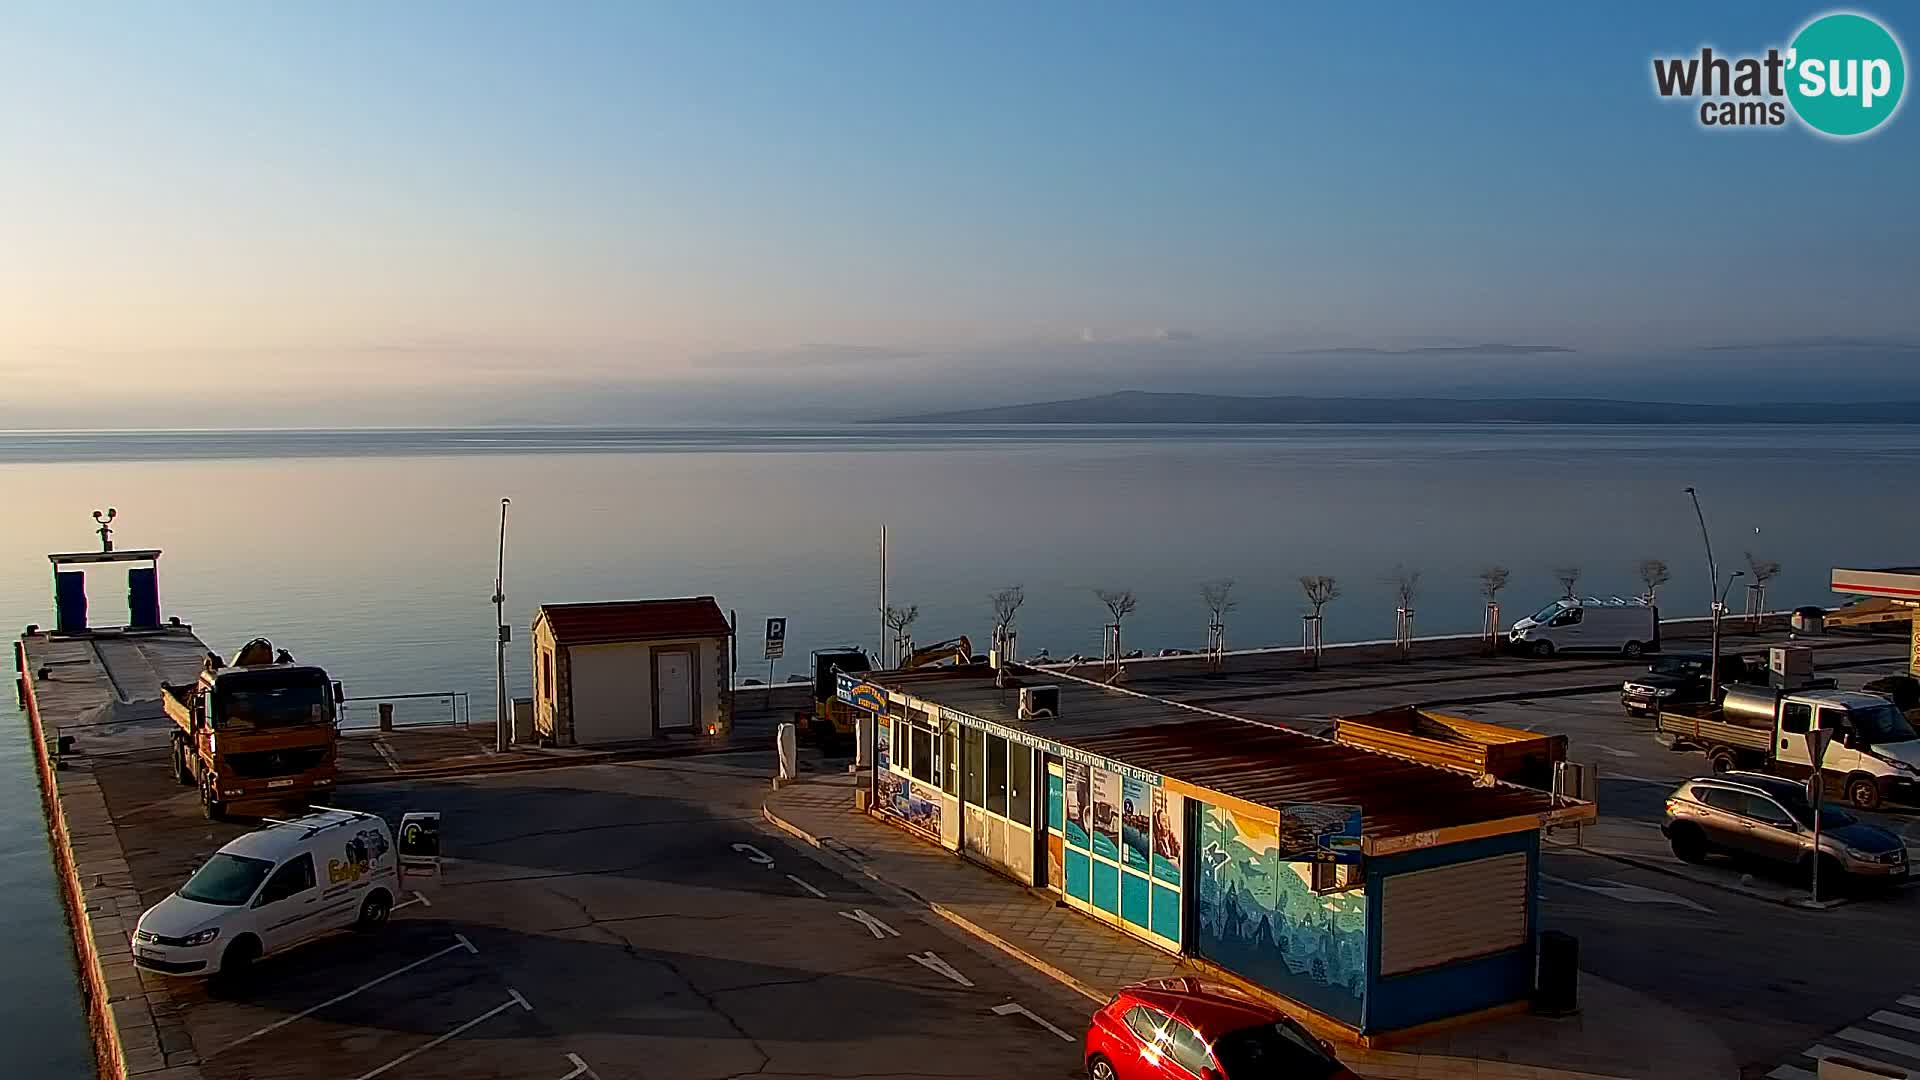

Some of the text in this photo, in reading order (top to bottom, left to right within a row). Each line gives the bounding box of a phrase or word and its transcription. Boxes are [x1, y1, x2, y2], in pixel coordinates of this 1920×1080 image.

[771, 621, 782, 637] P
[986, 722, 1021, 743] AUTOBUSNA
[1022, 734, 1051, 752] POSTAJA
[1060, 747, 1074, 759] BUS
[1075, 751, 1105, 769] STATION
[1106, 760, 1132, 777] TICKET
[1132, 769, 1158, 785] OFFICE
